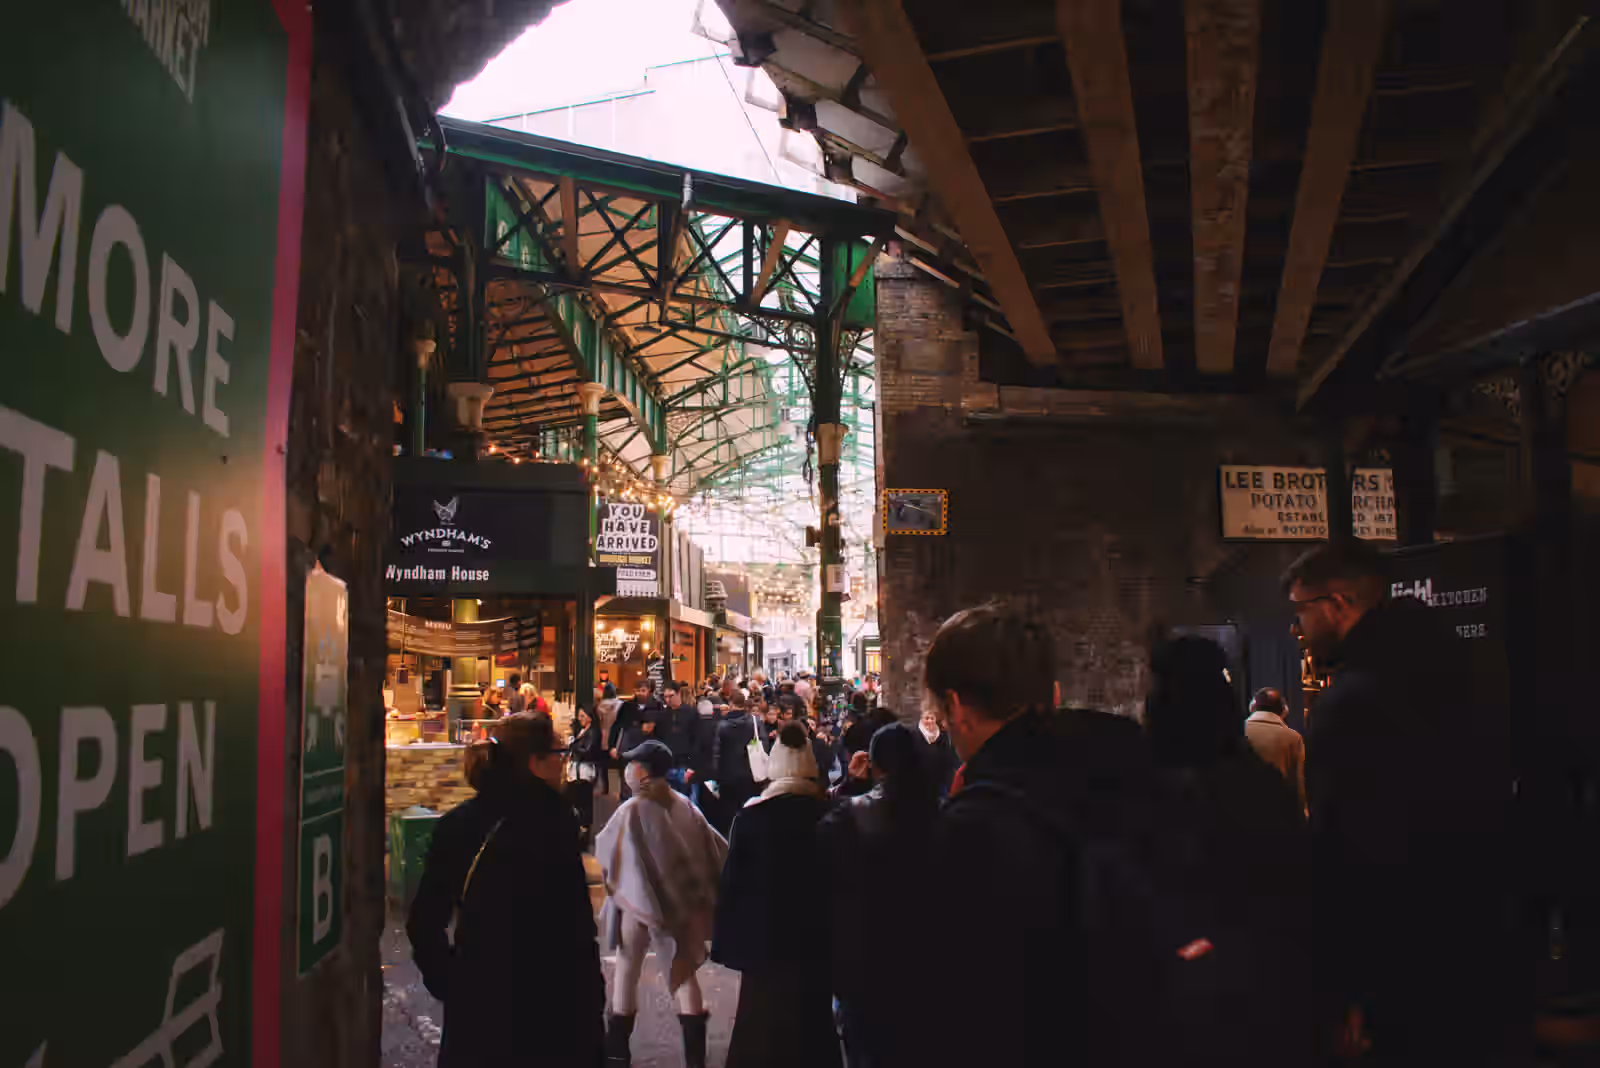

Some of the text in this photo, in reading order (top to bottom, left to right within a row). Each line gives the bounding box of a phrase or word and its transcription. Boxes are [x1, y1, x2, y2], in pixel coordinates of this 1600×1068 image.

[0, 99, 234, 438] MORE
[1225, 472, 1264, 489] LEE
[1250, 493, 1317, 509] POTATO
[610, 505, 641, 519] YOU
[605, 520, 648, 534] HAVE
[400, 528, 492, 550] WYNDHAM'S
[598, 535, 656, 550] ARRIVED
[451, 565, 490, 581] House
[312, 832, 333, 945] B
